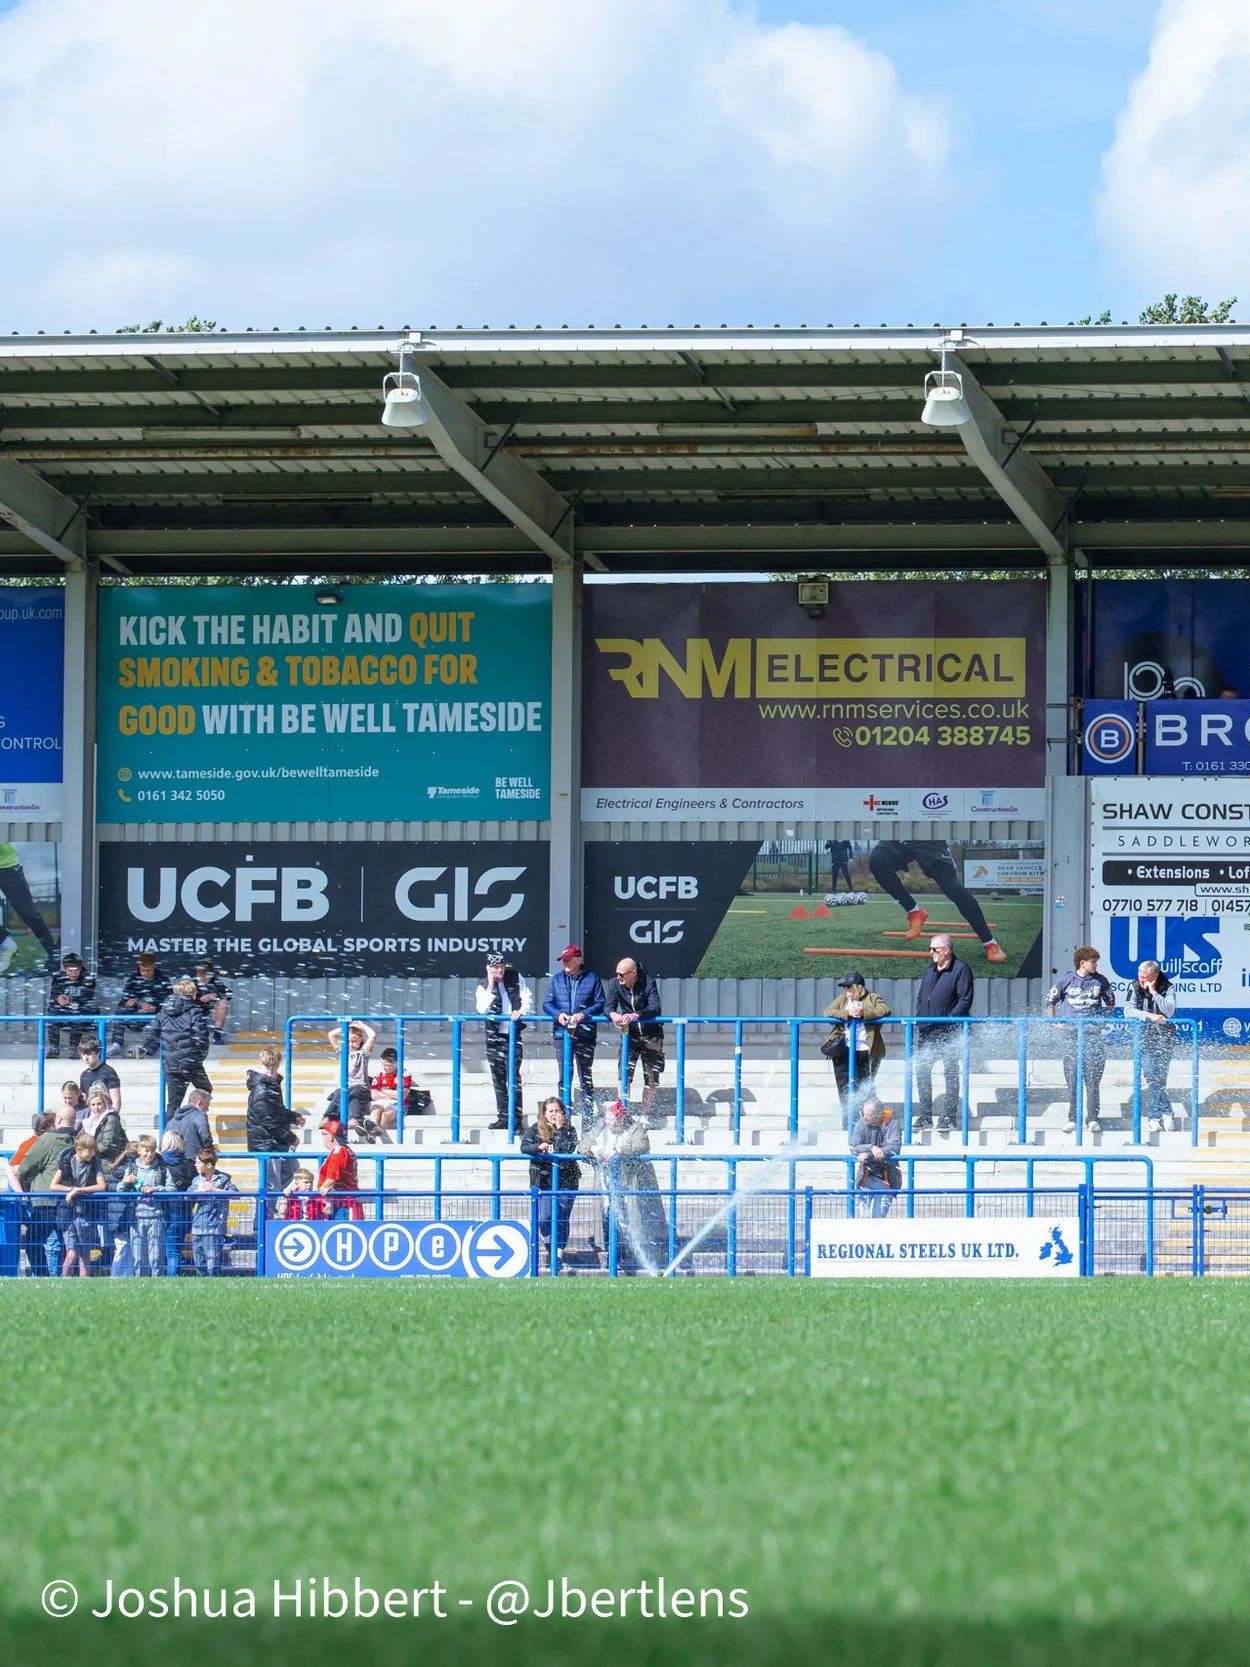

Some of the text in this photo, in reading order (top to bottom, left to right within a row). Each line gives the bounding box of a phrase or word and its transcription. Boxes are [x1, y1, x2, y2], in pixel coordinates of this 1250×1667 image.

[120, 611, 474, 648] KICK THE HABIT AND QUIT
[118, 654, 478, 688] SMOKING & TOBACCO FOR
[594, 638, 1013, 698] RNM ELECTRICAL
[758, 699, 1029, 720] www.rnmservices.co.uk
[118, 701, 542, 736] GOOD WITH BE WELL TAMESIDE
[856, 725, 1030, 746] 01204 388745
[1102, 730, 1118, 748] B
[138, 766, 379, 780] www.tameside.gov.uk/bewelltameside
[1183, 762, 1192, 770] T:
[1196, 762, 1224, 770] 0161
[1230, 762, 1250, 770] 330
[496, 777, 532, 787] BE WELL
[138, 789, 225, 801] 0161 342 5050
[438, 786, 480, 794] Tameside
[495, 788, 540, 798] TAMESIDE
[596, 798, 804, 812] Electrical Engineers & Contractors
[1103, 804, 1172, 821] SHAW
[1137, 866, 1210, 879] Extensions
[127, 866, 527, 922] UCFB GIS
[614, 876, 698, 900] UCFB
[1102, 900, 1142, 912] 07710
[1148, 900, 1174, 912] 577
[1177, 900, 1198, 912] 718
[630, 920, 684, 944] GIS
[128, 938, 527, 952] MASTER THE GLOBAL SPORTS INDUSTRY
[1200, 982, 1222, 992] LTD
[818, 1243, 1019, 1258] REGIONAL STEELS UK LTD.
